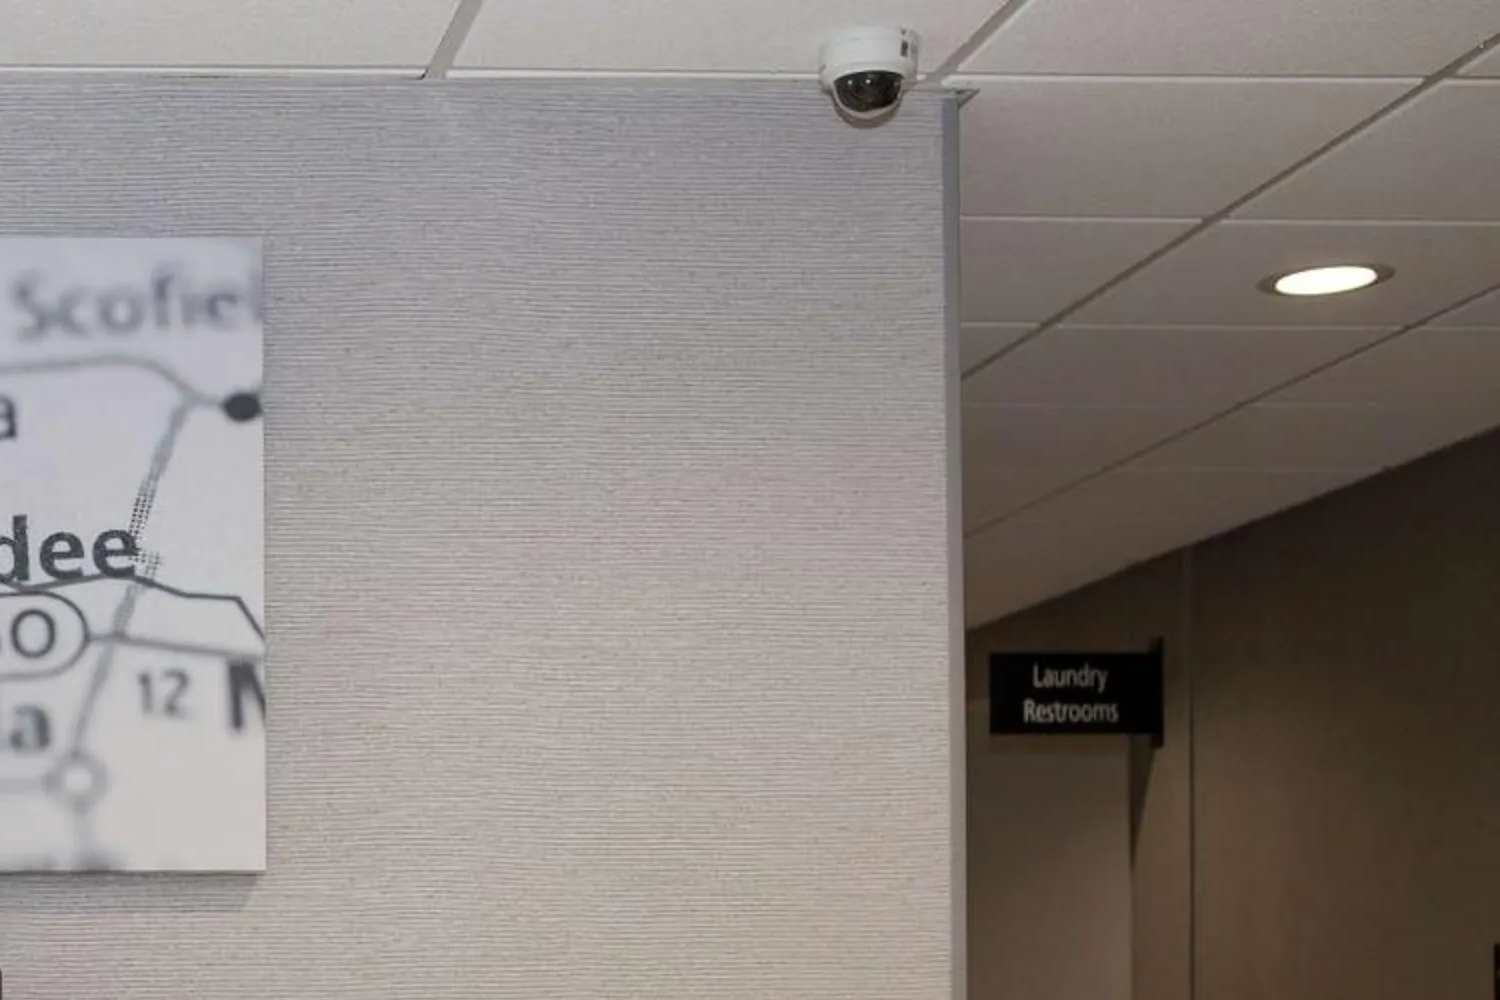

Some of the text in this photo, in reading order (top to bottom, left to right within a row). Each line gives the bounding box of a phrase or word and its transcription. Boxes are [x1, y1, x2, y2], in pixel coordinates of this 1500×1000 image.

[136, 666, 194, 720] 12
[1032, 661, 1108, 693] Laundry
[1022, 697, 1120, 723] Restrooms
